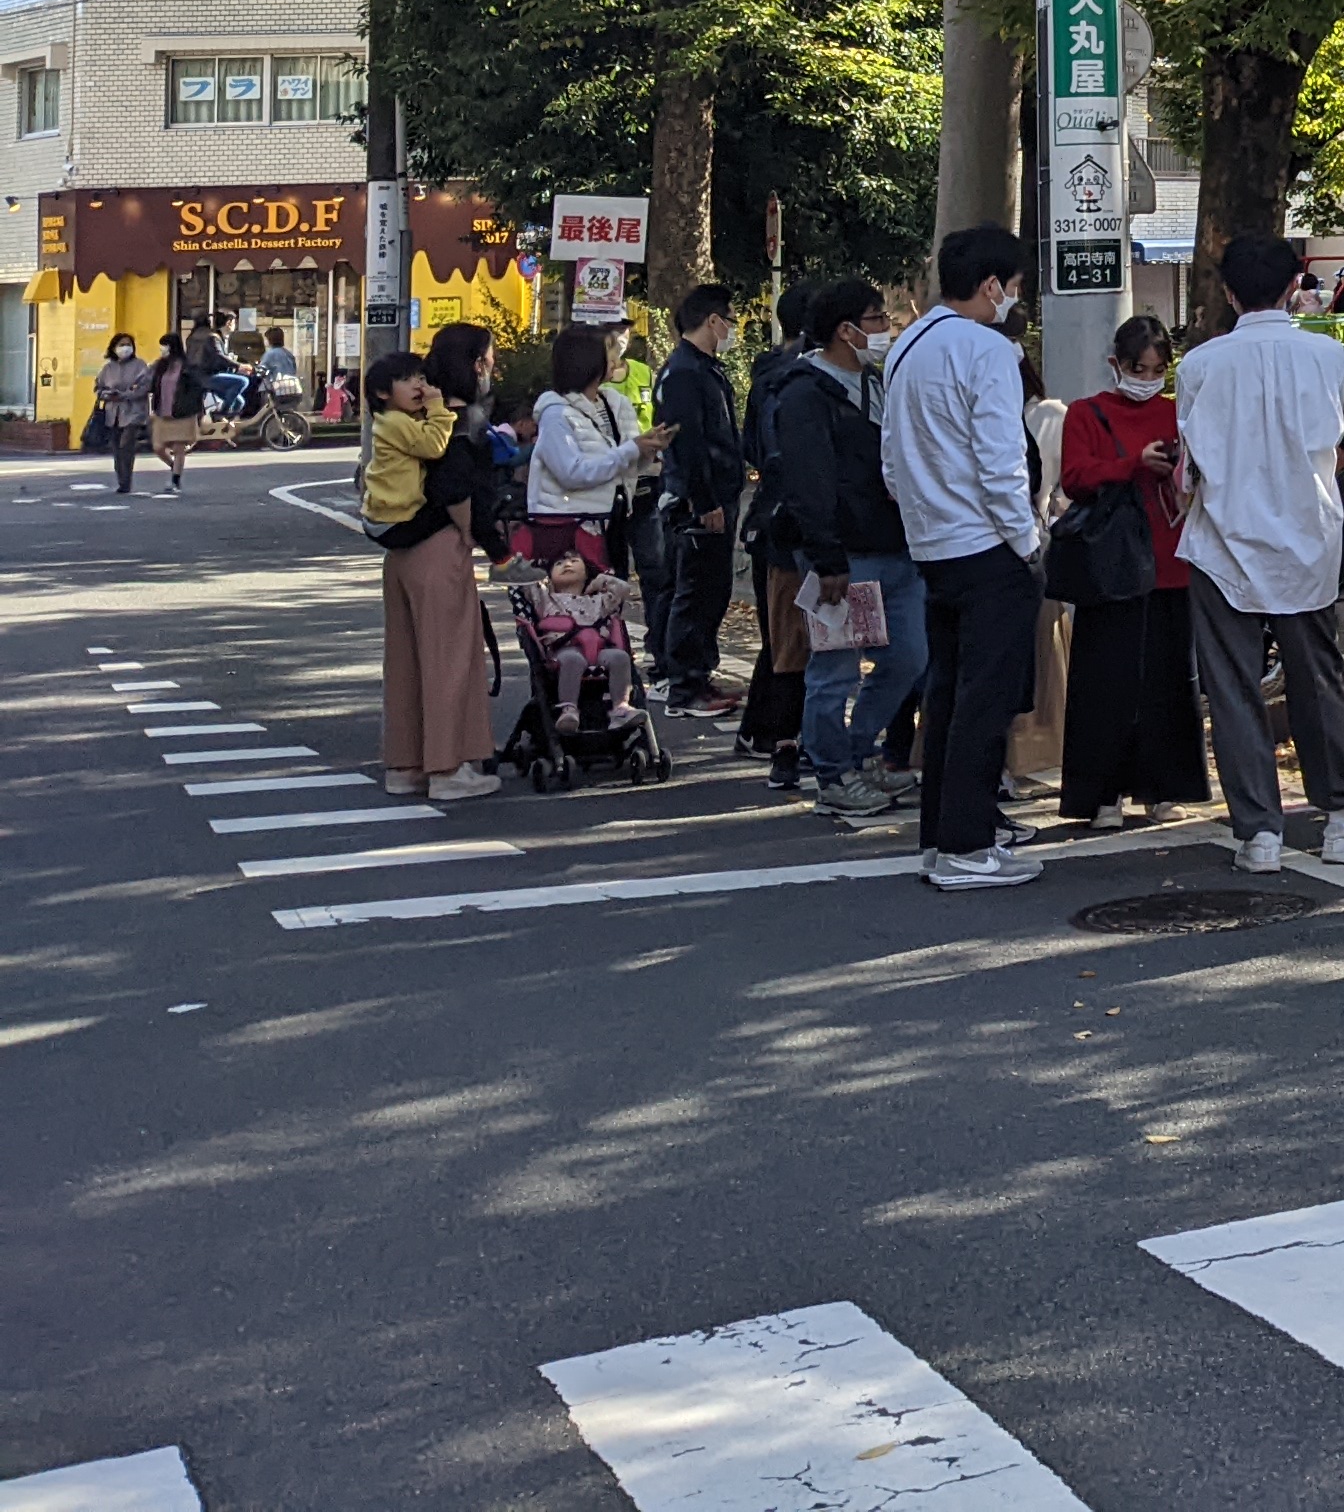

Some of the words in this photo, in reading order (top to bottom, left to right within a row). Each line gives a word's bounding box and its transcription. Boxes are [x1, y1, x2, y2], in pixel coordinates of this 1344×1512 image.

[180, 200, 341, 236] S.C.D.F
[1054, 218, 1123, 233] 3312-0007
[557, 215, 642, 244] 最後尾
[172, 240, 200, 251] Shin
[202, 239, 248, 250] Castella
[251, 238, 295, 249] Dessert
[297, 237, 342, 250] Factory
[1063, 252, 1116, 267] 高円寺南
[1067, 270, 1111, 285] 4-31
